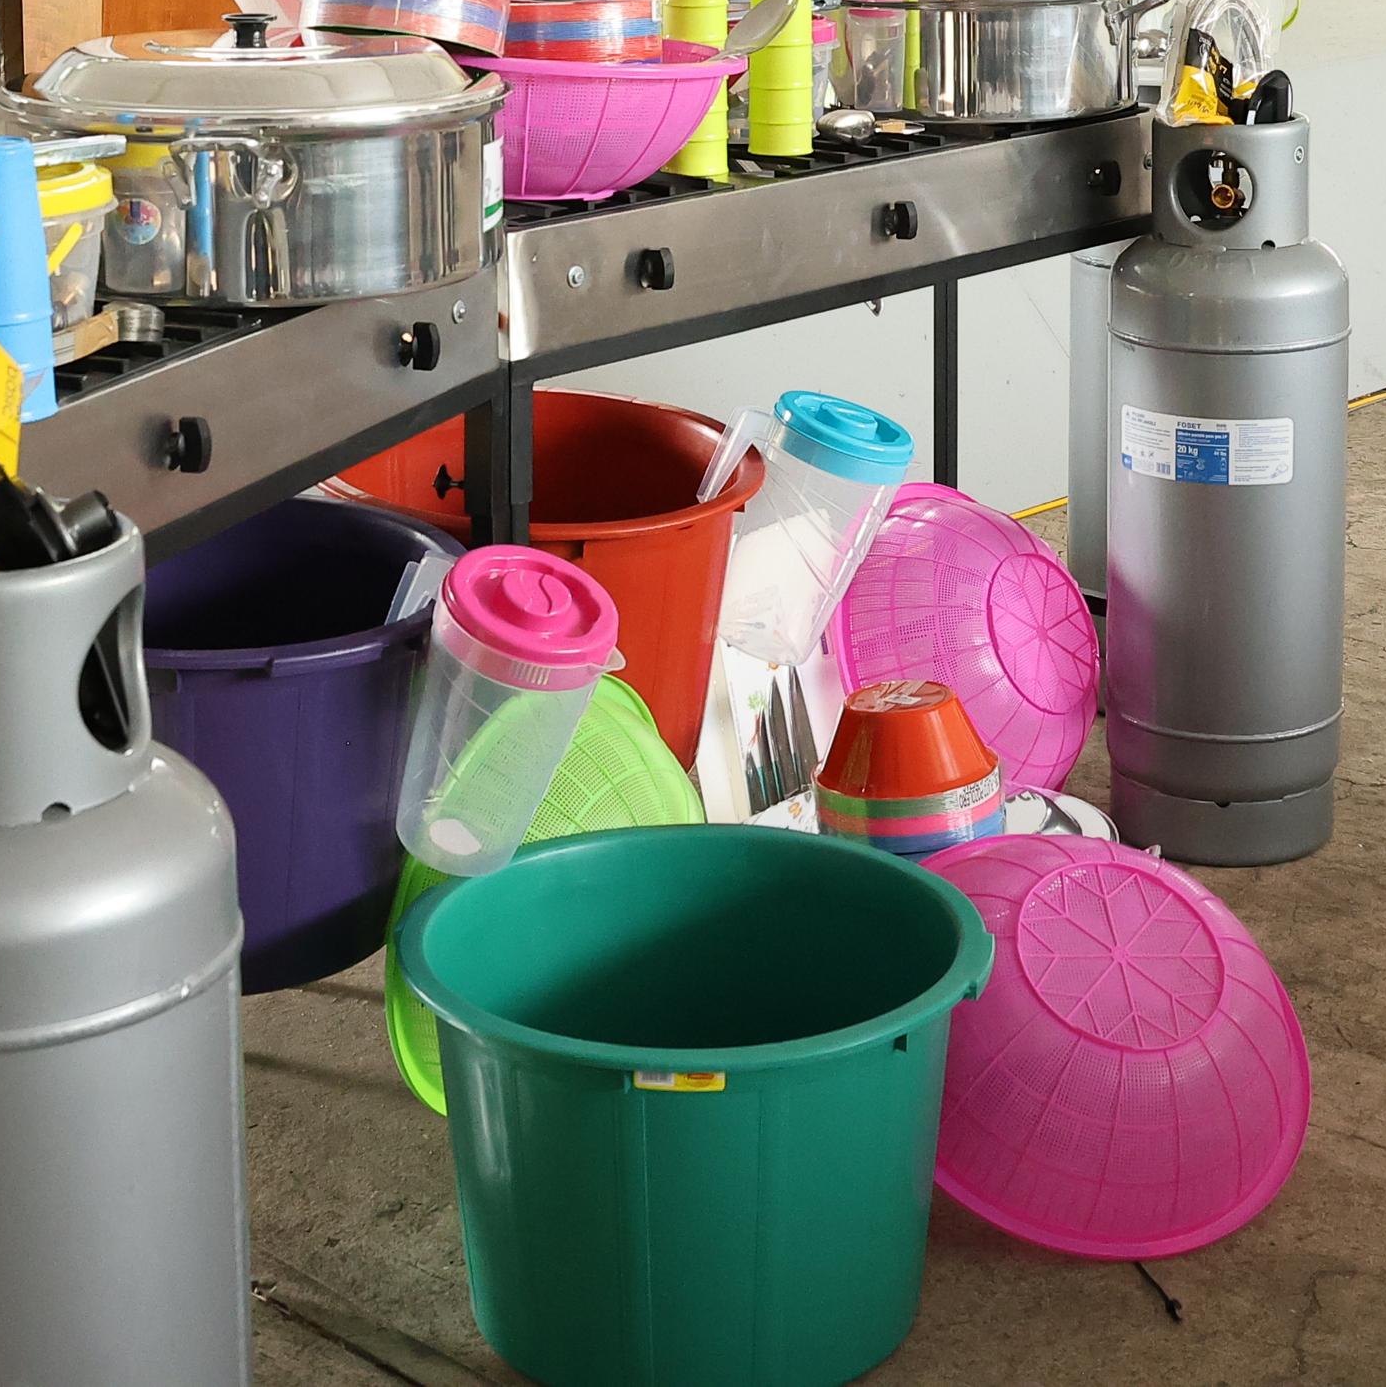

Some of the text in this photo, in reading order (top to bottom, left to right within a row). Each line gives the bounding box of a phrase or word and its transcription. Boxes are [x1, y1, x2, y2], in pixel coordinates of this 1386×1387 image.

[1176, 421, 1202, 429] FOSET
[1177, 444, 1199, 458] 20 kg
